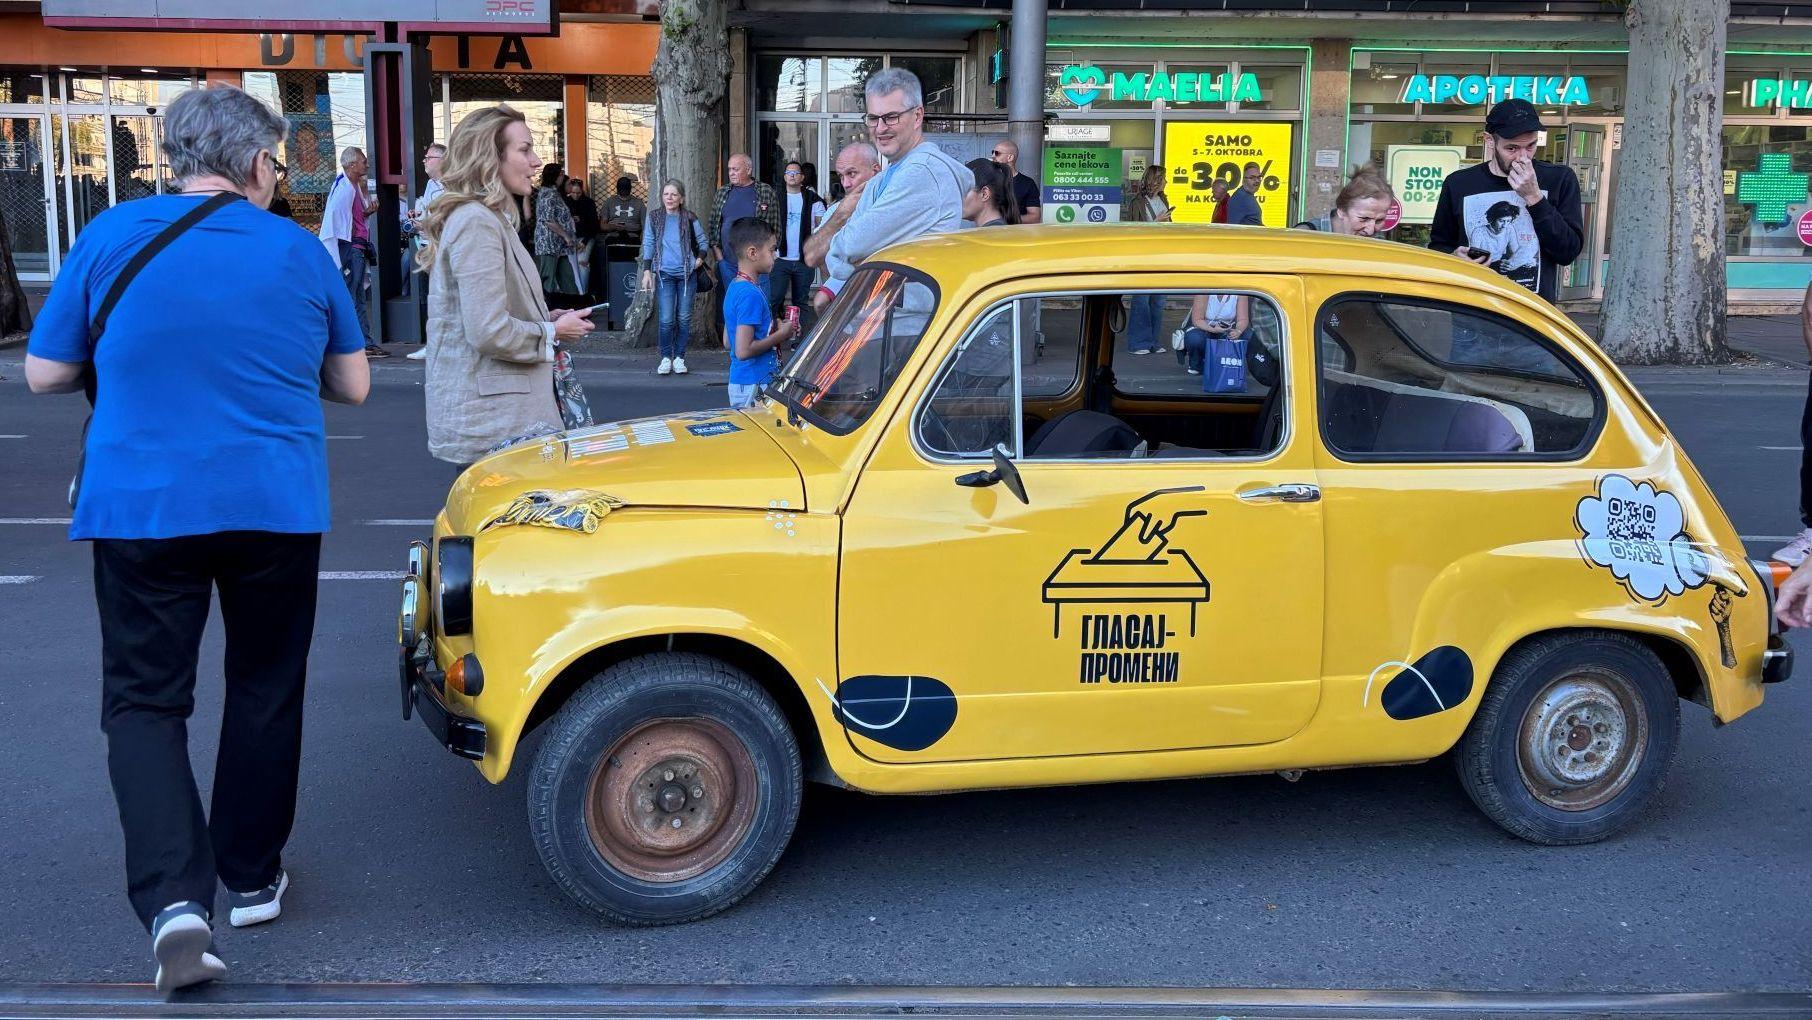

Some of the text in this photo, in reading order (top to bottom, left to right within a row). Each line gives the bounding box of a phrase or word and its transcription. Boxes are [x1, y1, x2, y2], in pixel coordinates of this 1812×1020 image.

[1112, 72, 1262, 102] MAELIA
[1403, 75, 1590, 105] APOTEKA
[1205, 134, 1252, 147] SAMO
[1054, 151, 1096, 161] Saznajte
[1215, 148, 1263, 156] OKTOBRA
[1054, 160, 1110, 169] cene lekova
[1174, 167, 1187, 175] do
[1409, 167, 1442, 178] NON
[1053, 176, 1110, 184] 0800 444 555
[1405, 179, 1442, 190] STOP
[1186, 195, 1201, 203] NA
[1403, 191, 1439, 203] 00-2
[1081, 614, 1175, 650] ГЛАСАЈ-
[1080, 652, 1179, 684] ПРОМЕНИ
